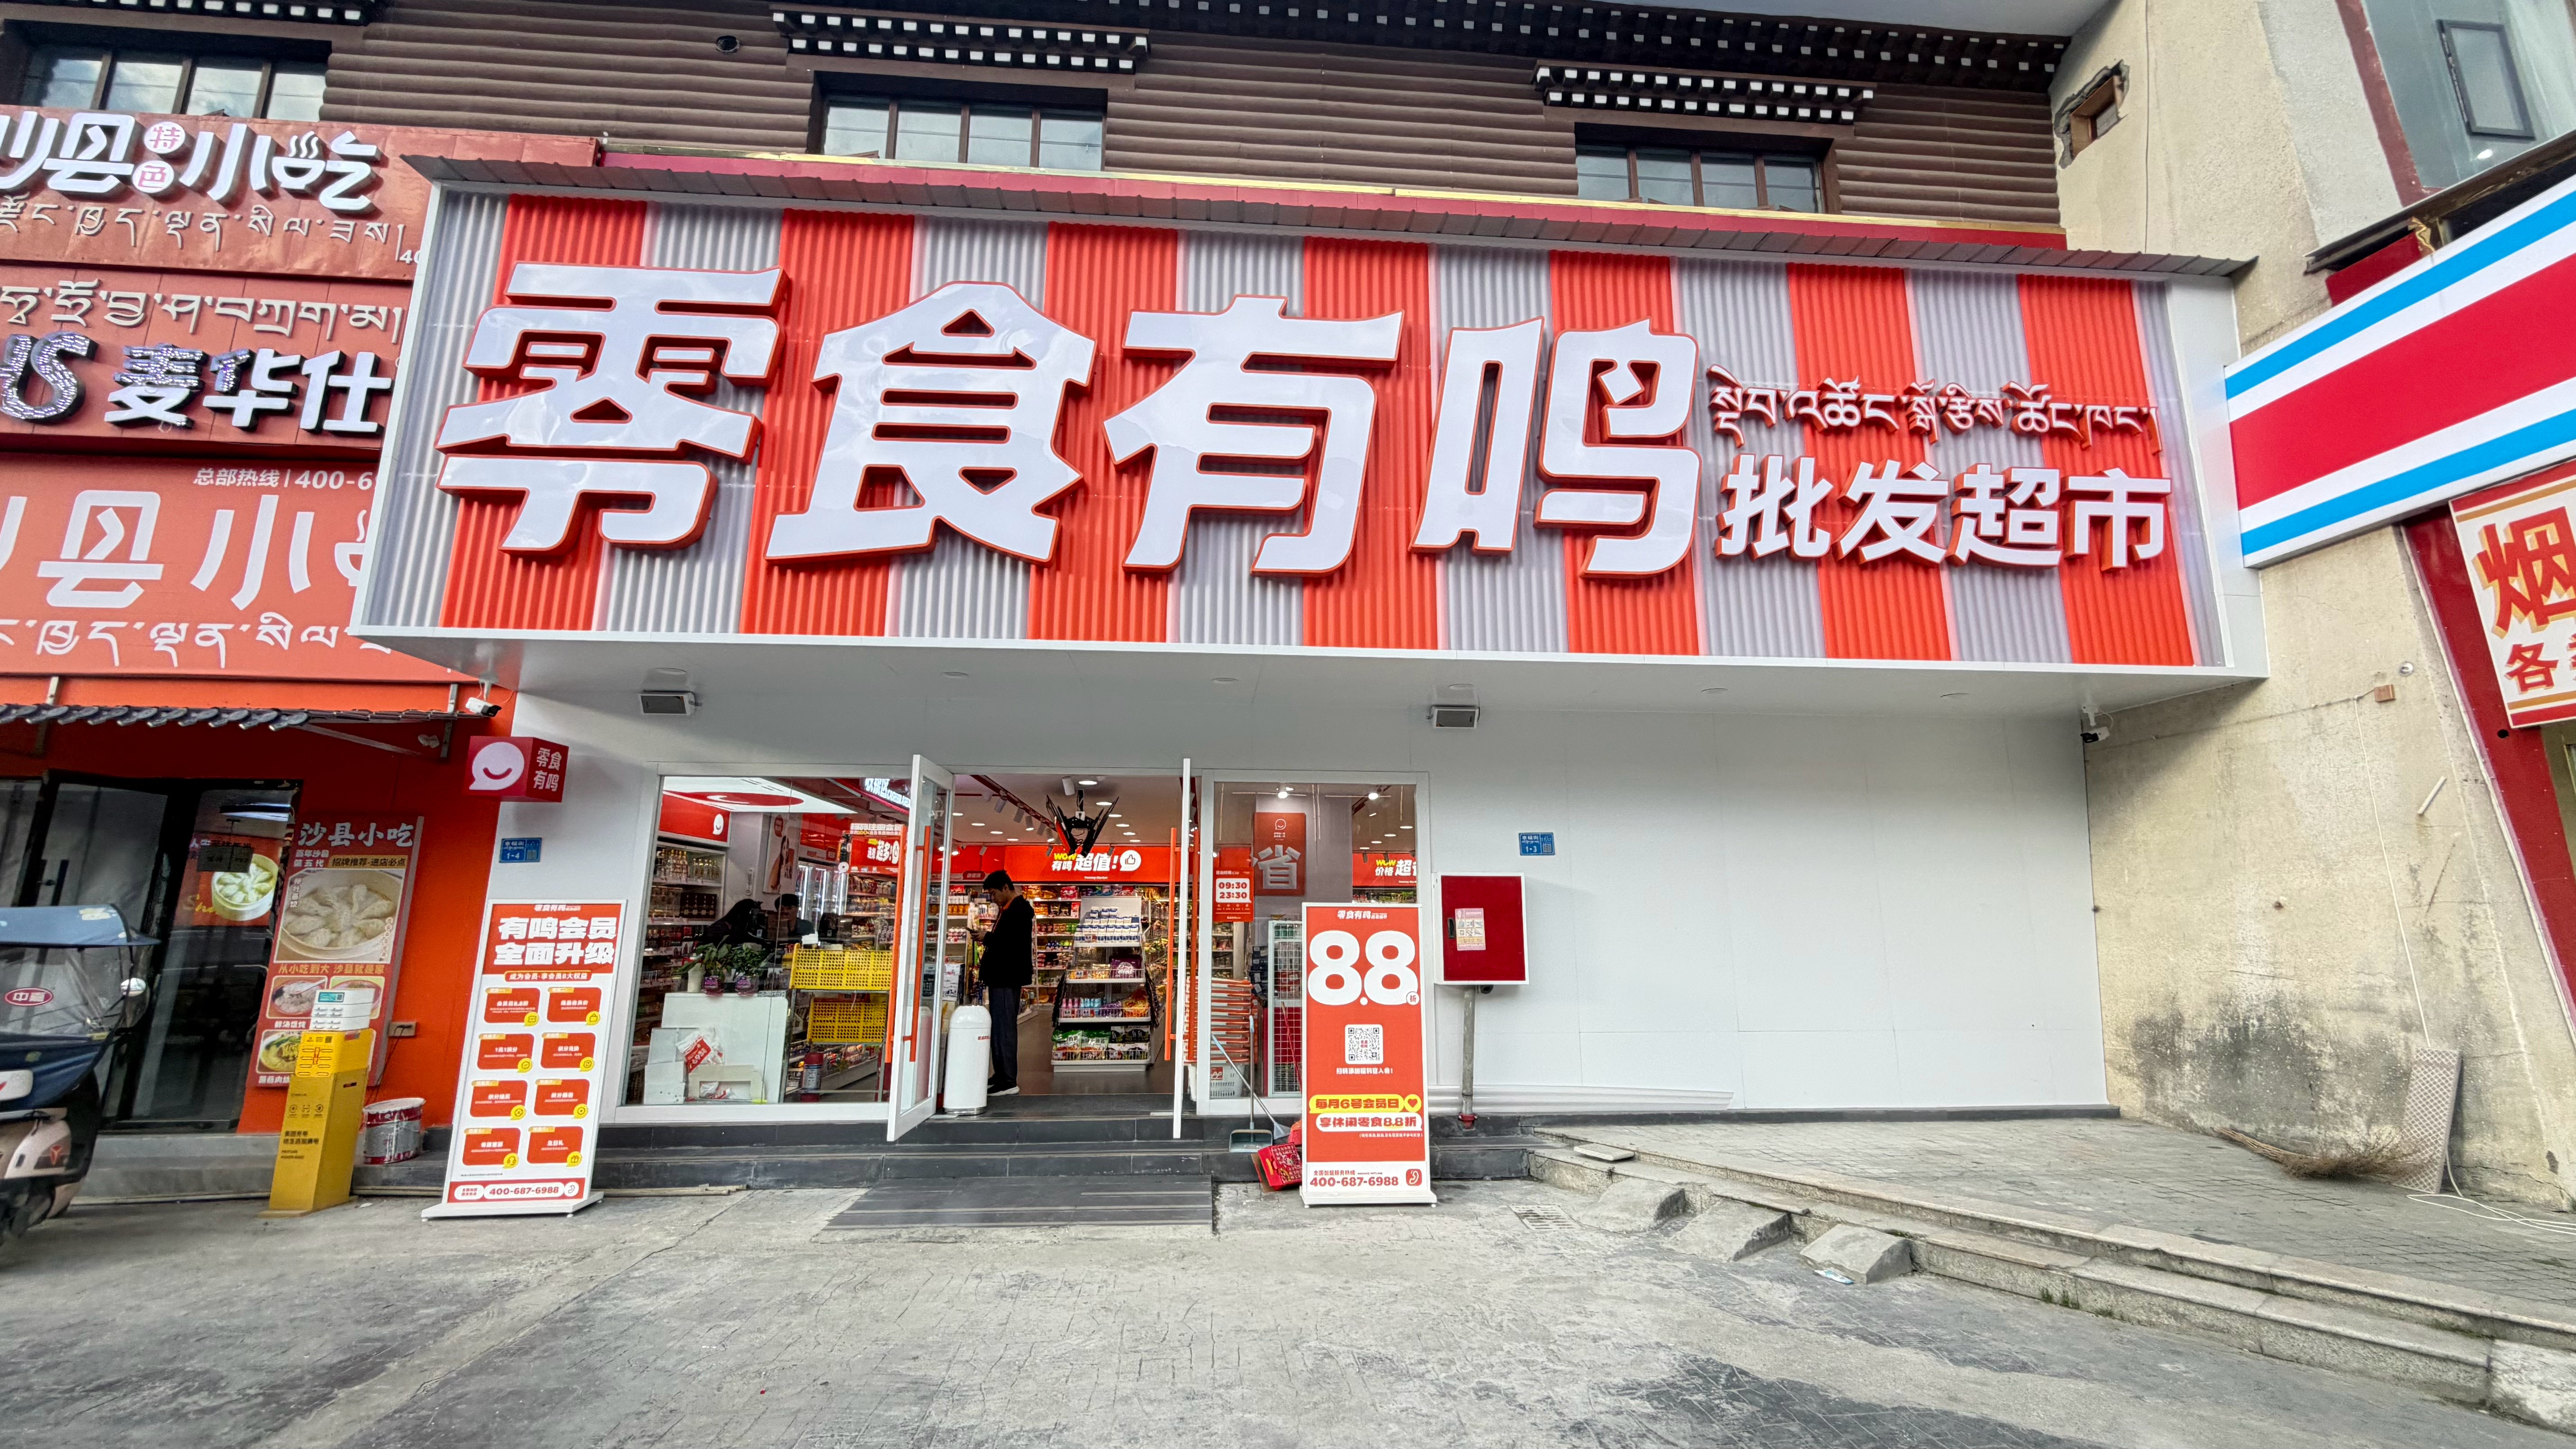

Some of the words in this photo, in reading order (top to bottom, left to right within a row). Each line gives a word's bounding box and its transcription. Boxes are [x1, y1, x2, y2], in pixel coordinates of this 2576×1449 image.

[105, 343, 393, 434] 麦华仕
[437, 264, 1701, 578] 零食有鸣
[193, 468, 280, 487] 总部热线
[294, 470, 377, 491] 400-6
[1716, 453, 2171, 572] 批发超市
[536, 747, 562, 771] 零食
[298, 822, 414, 847] 沙县小吃
[1257, 844, 1301, 890] 省
[498, 917, 617, 940] 有鸣会员
[493, 942, 615, 965] 全面升级
[1316, 1098, 1399, 1109] 每月6号会员日
[489, 1186, 560, 1196] 400-687-6988
[1310, 1176, 1399, 1187] 400-687-6988
